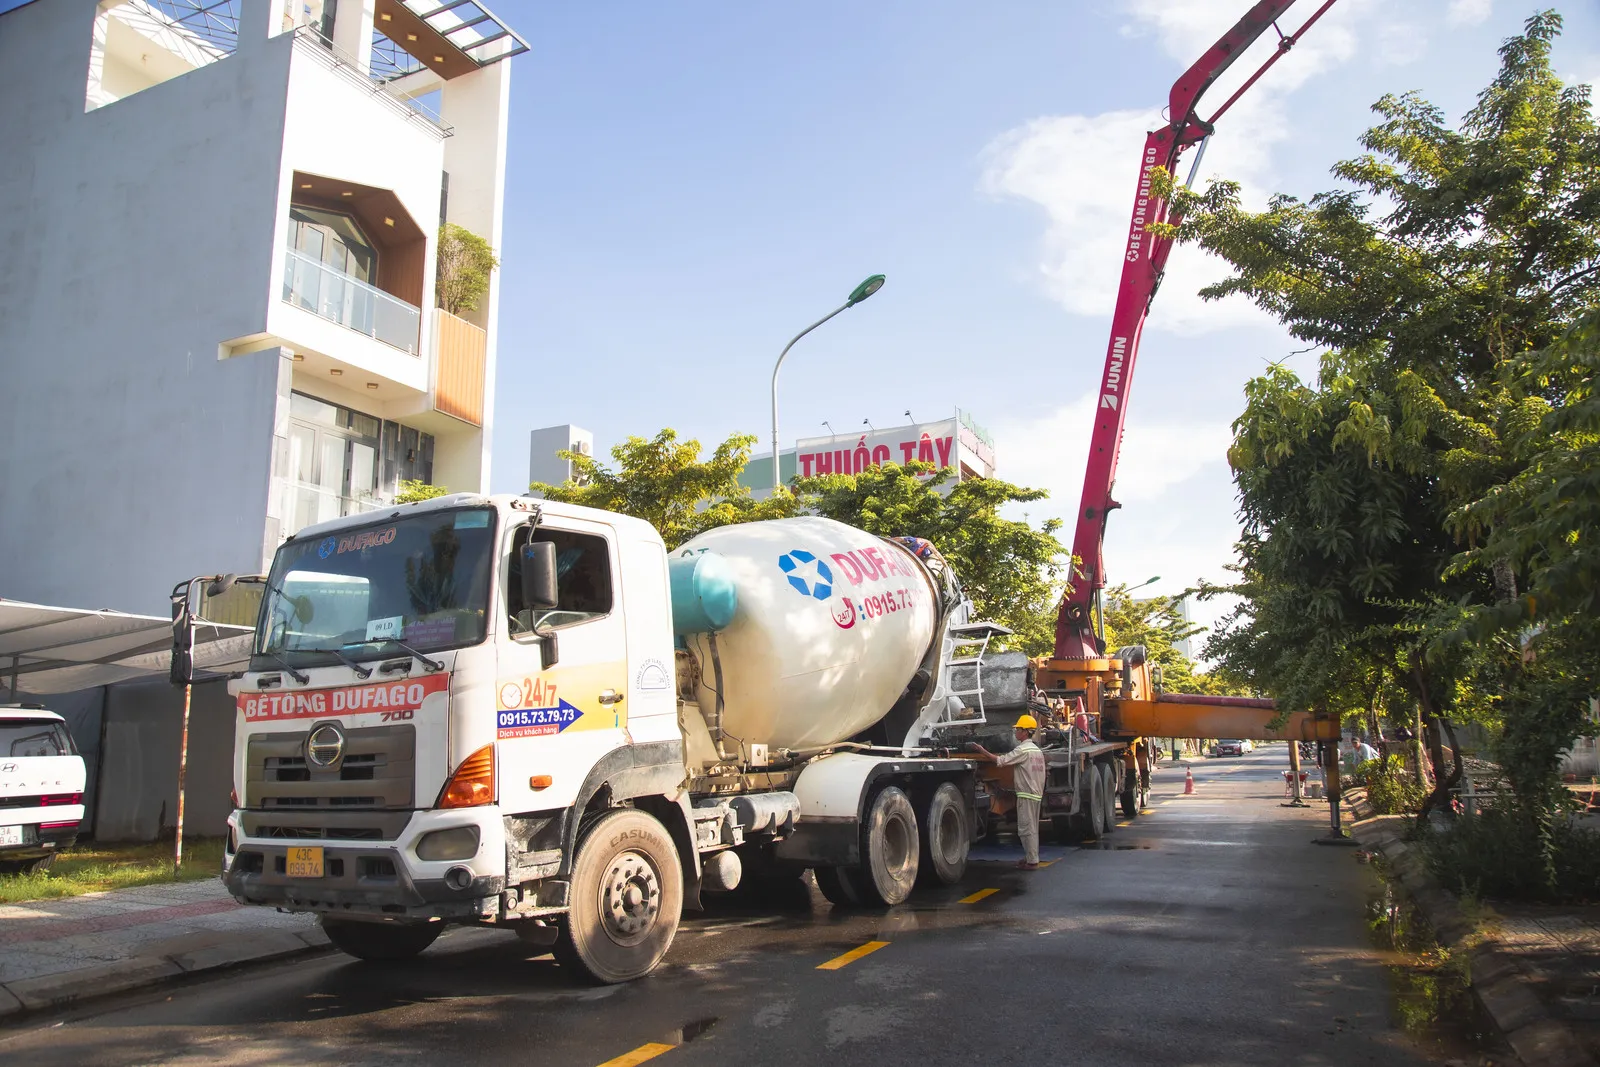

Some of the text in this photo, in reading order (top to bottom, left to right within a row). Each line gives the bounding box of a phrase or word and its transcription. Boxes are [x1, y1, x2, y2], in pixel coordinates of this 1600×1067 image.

[1106, 336, 1127, 392] JUNJIN
[900, 432, 953, 477] TÂY
[337, 527, 397, 554] DUFAGO
[837, 609, 850, 623] 24/7
[246, 683, 425, 718] BÊTÔNG DUFAGO
[523, 677, 557, 708] 24/7
[380, 709, 414, 722] 700
[500, 708, 575, 726] 0915.73.79.73
[500, 730, 514, 739] Dịch
[524, 727, 543, 736] khách
[296, 848, 312, 860] 43C
[290, 862, 319, 875] 099.74
